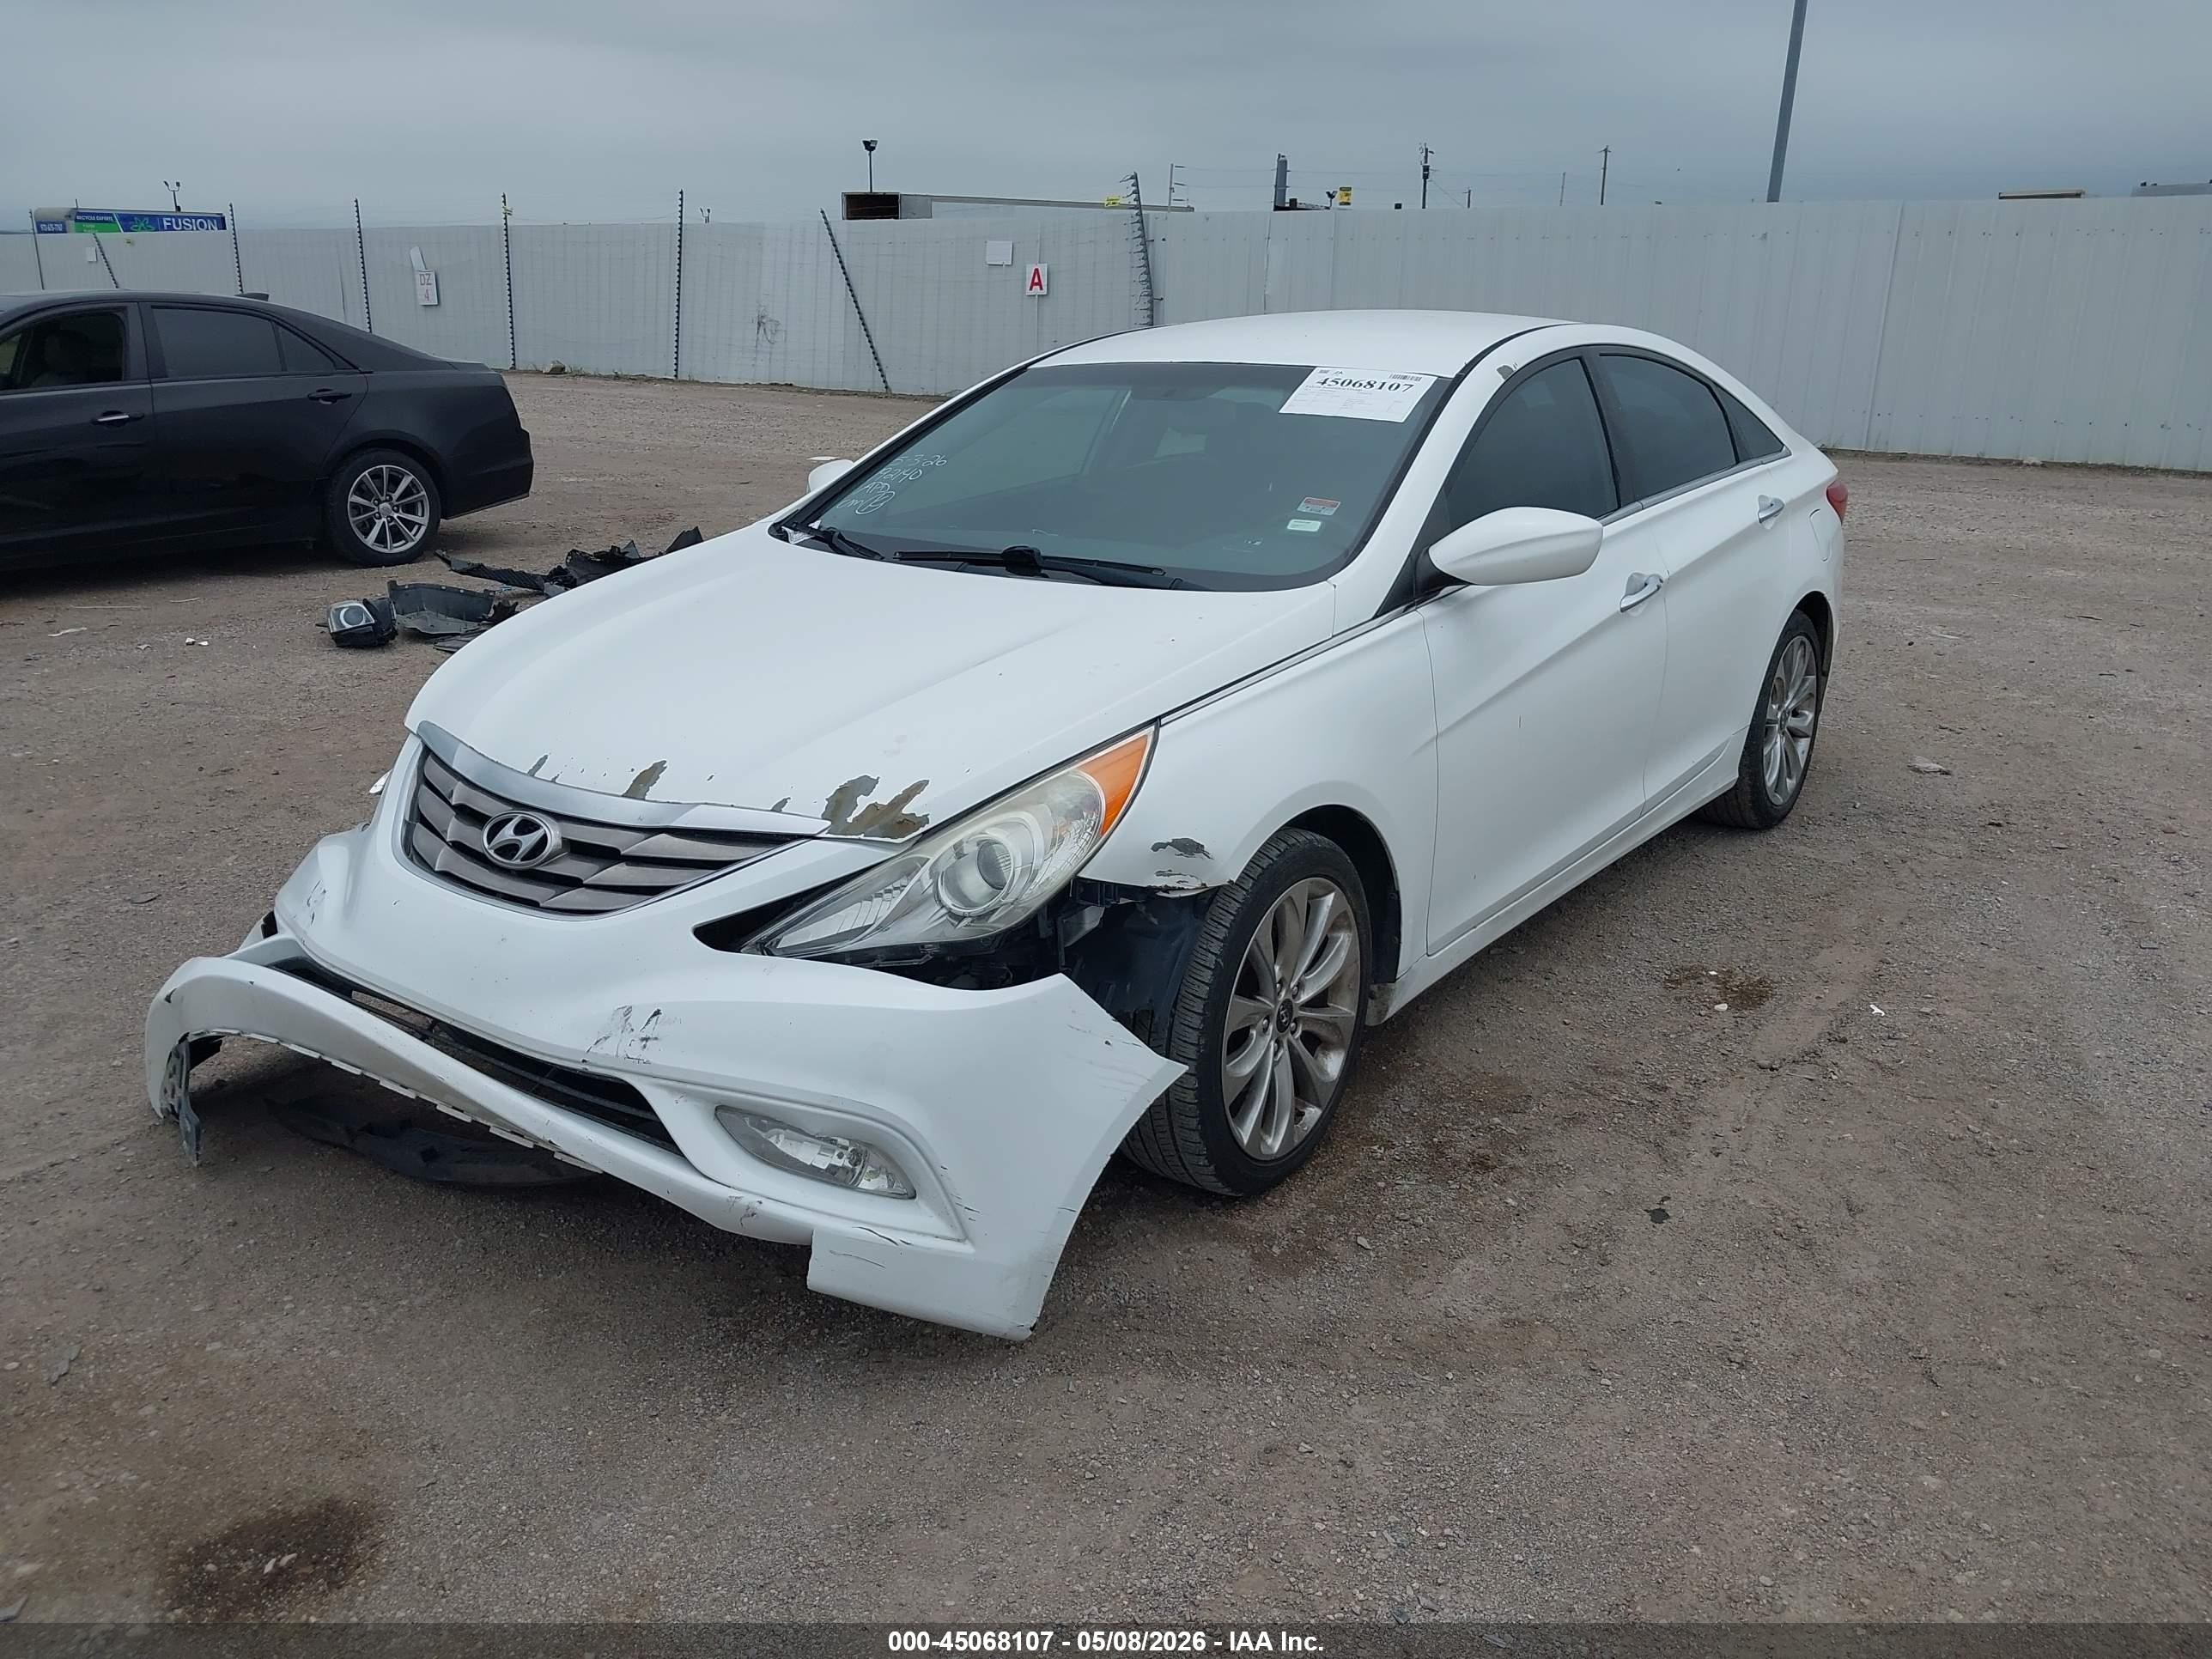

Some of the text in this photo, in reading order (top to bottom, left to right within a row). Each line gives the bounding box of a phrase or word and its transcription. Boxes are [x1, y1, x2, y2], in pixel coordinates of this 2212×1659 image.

[162, 217, 218, 230] FUSION
[1029, 267, 1044, 292] A
[1316, 377, 1415, 392] 45068107
